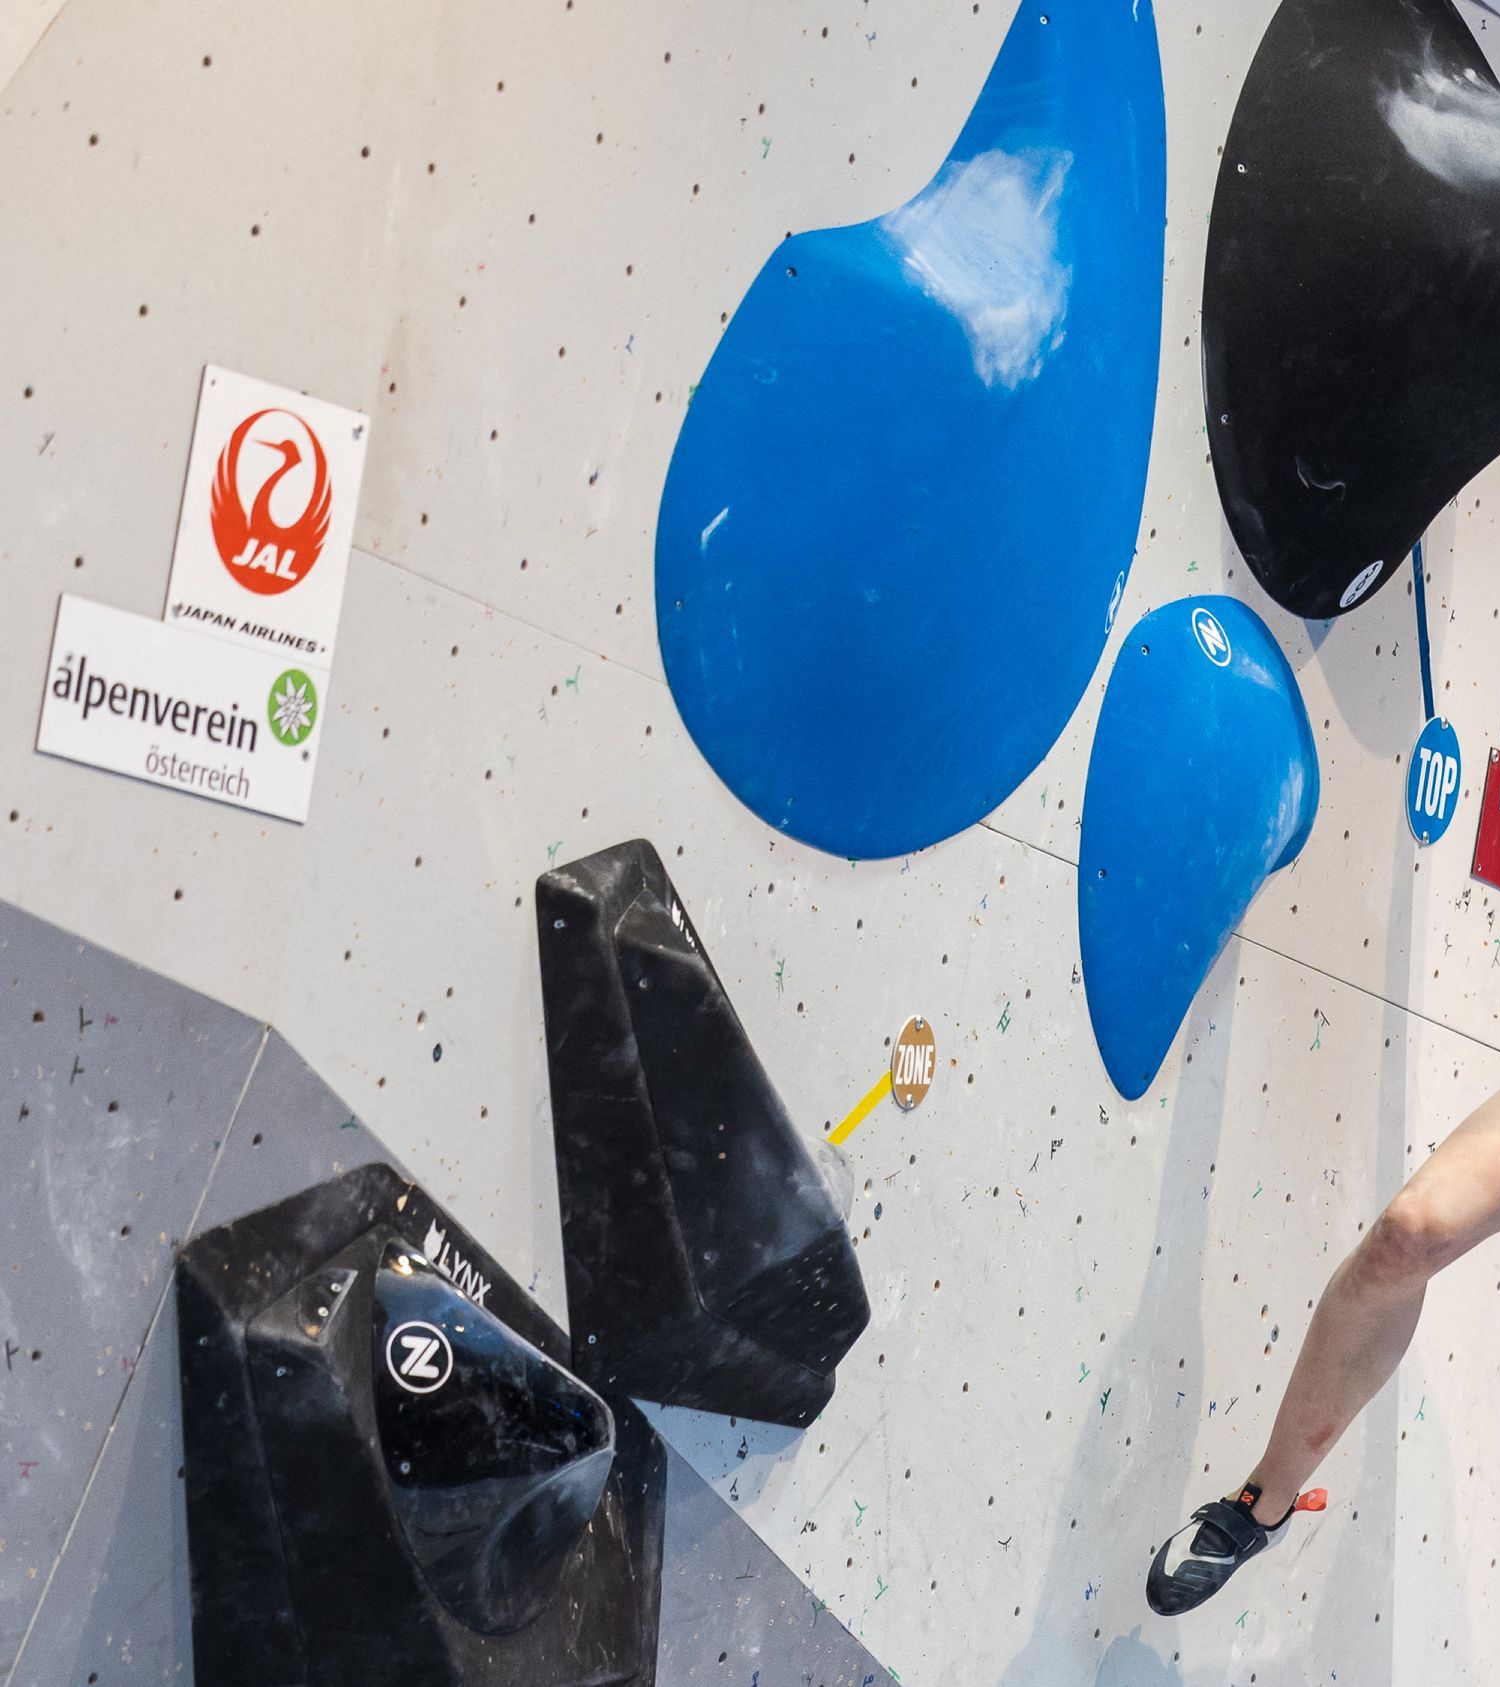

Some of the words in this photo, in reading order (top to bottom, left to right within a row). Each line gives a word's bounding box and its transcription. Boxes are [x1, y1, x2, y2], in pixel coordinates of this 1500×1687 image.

[232, 538, 297, 581] JAL
[184, 605, 237, 629] JAPAN
[239, 622, 317, 653] AIRLINES
[53, 656, 258, 753] alpenverein
[145, 745, 250, 800] österreich
[1415, 747, 1458, 820] TOP
[896, 1044, 934, 1085] ZONE
[438, 1242, 492, 1306] LYNX
